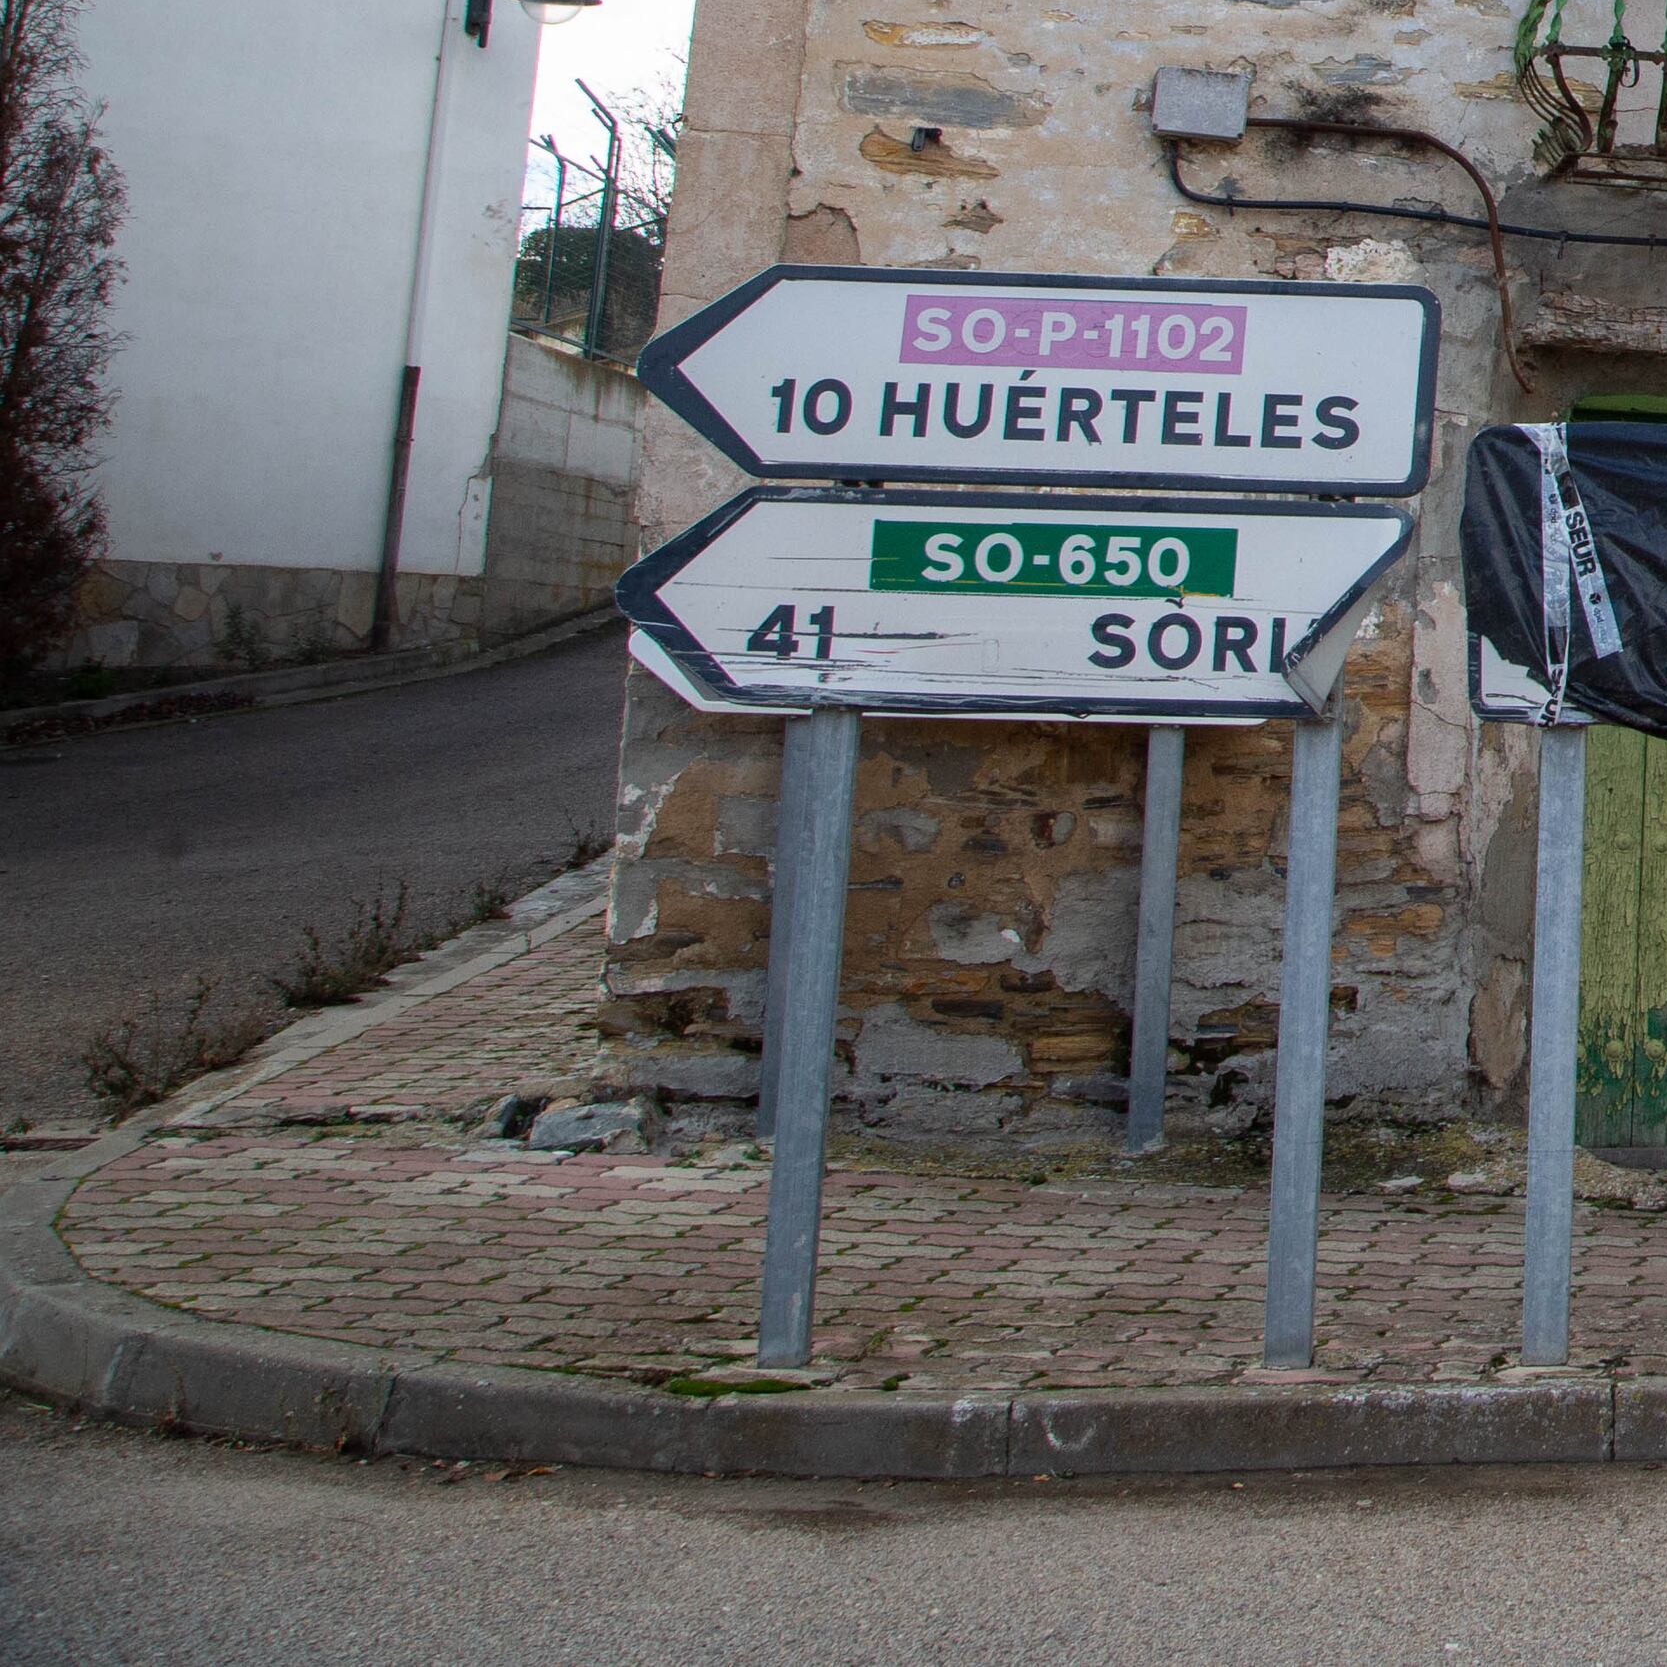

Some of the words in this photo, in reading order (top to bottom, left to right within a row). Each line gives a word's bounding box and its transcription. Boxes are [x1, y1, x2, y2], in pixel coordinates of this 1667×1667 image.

[911, 307, 1235, 363] SO-P-1102
[772, 377, 853, 435] 10
[878, 370, 1361, 450] HUÉRTELES
[920, 532, 1192, 589] SO-650
[1565, 510, 1597, 579] SEUR
[746, 604, 836, 661] 41
[1088, 612, 1322, 674] SORI
